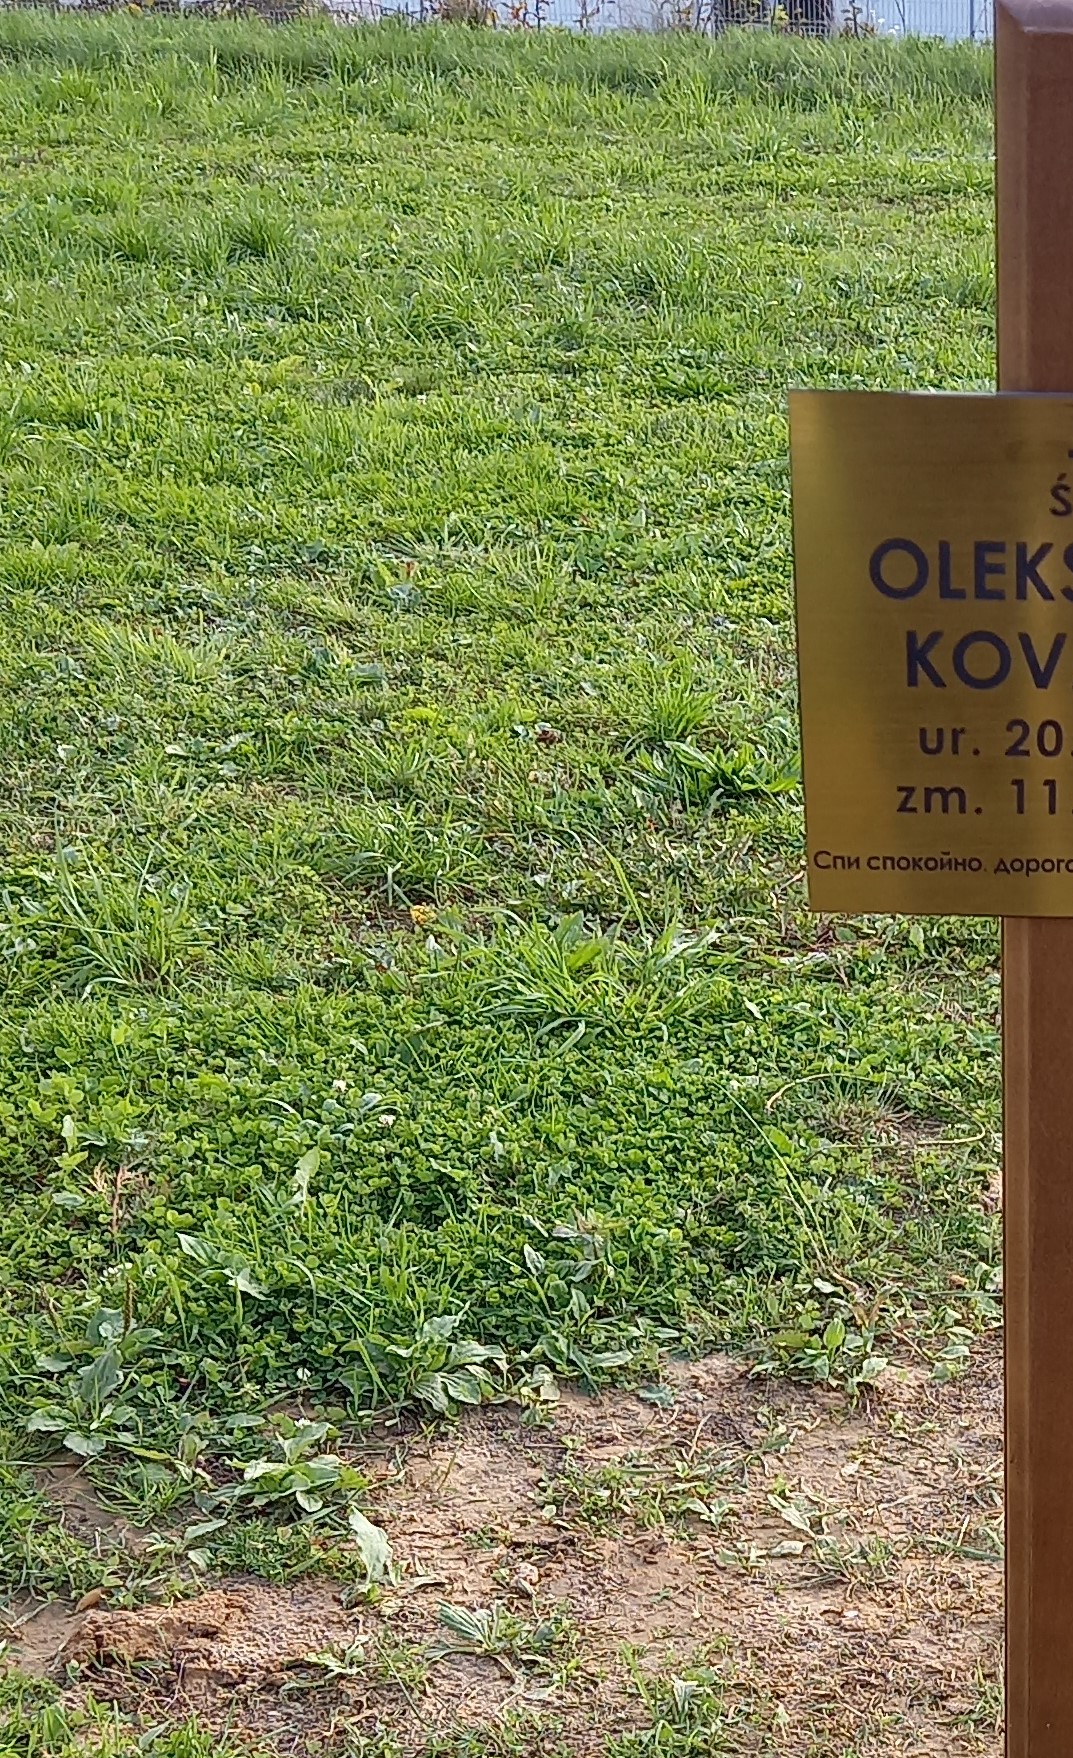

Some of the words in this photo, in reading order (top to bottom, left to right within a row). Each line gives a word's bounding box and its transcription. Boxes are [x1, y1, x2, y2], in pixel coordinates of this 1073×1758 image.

[918, 726, 982, 757] ur.
[896, 785, 984, 816] zm.
[813, 850, 861, 871] Спи
